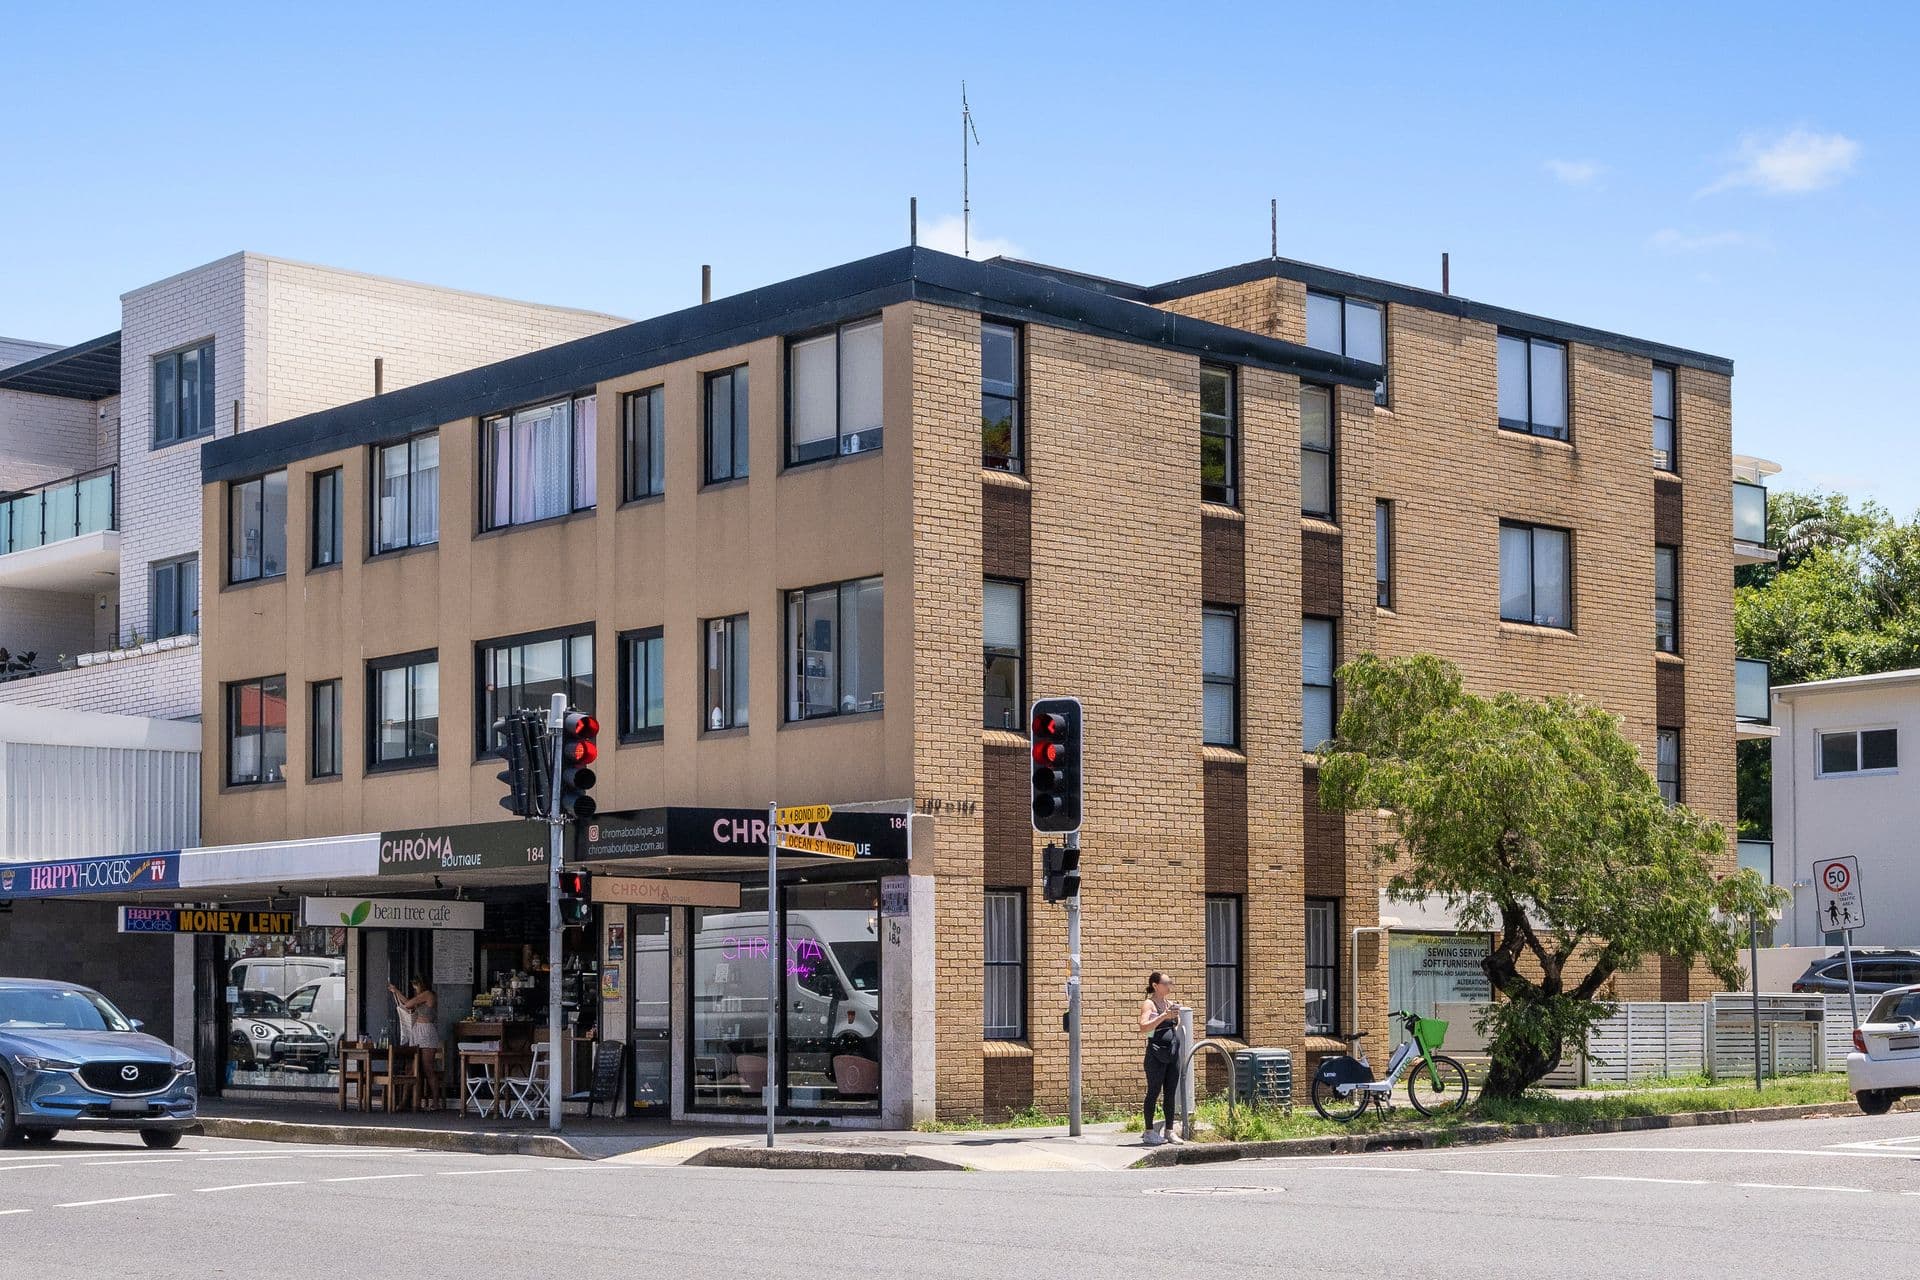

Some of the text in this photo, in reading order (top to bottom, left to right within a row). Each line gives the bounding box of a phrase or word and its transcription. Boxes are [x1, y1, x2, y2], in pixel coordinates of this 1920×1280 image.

[794, 808, 826, 821] BONDI RD
[890, 817, 908, 829] 184
[602, 826, 664, 839] chromaboutique_au
[713, 818, 828, 844] CHRMA
[589, 842, 664, 855] chromaboutique.com.au
[788, 835, 812, 849] OCEAN
[815, 840, 824, 852] ST
[826, 841, 850, 857] NORTH
[442, 854, 482, 868] BOUTIQUE
[526, 847, 544, 862] 184
[151, 863, 166, 881] TV
[1829, 871, 1845, 884] 50
[374, 903, 451, 922] bean tree cafe
[127, 919, 173, 931] HOCKERS
[180, 911, 292, 933] MONEY LENT
[722, 937, 822, 959] CHRMA
[1427, 947, 1458, 957] SEWING
[1422, 959, 1484, 969] SOFT FURNISHIN
